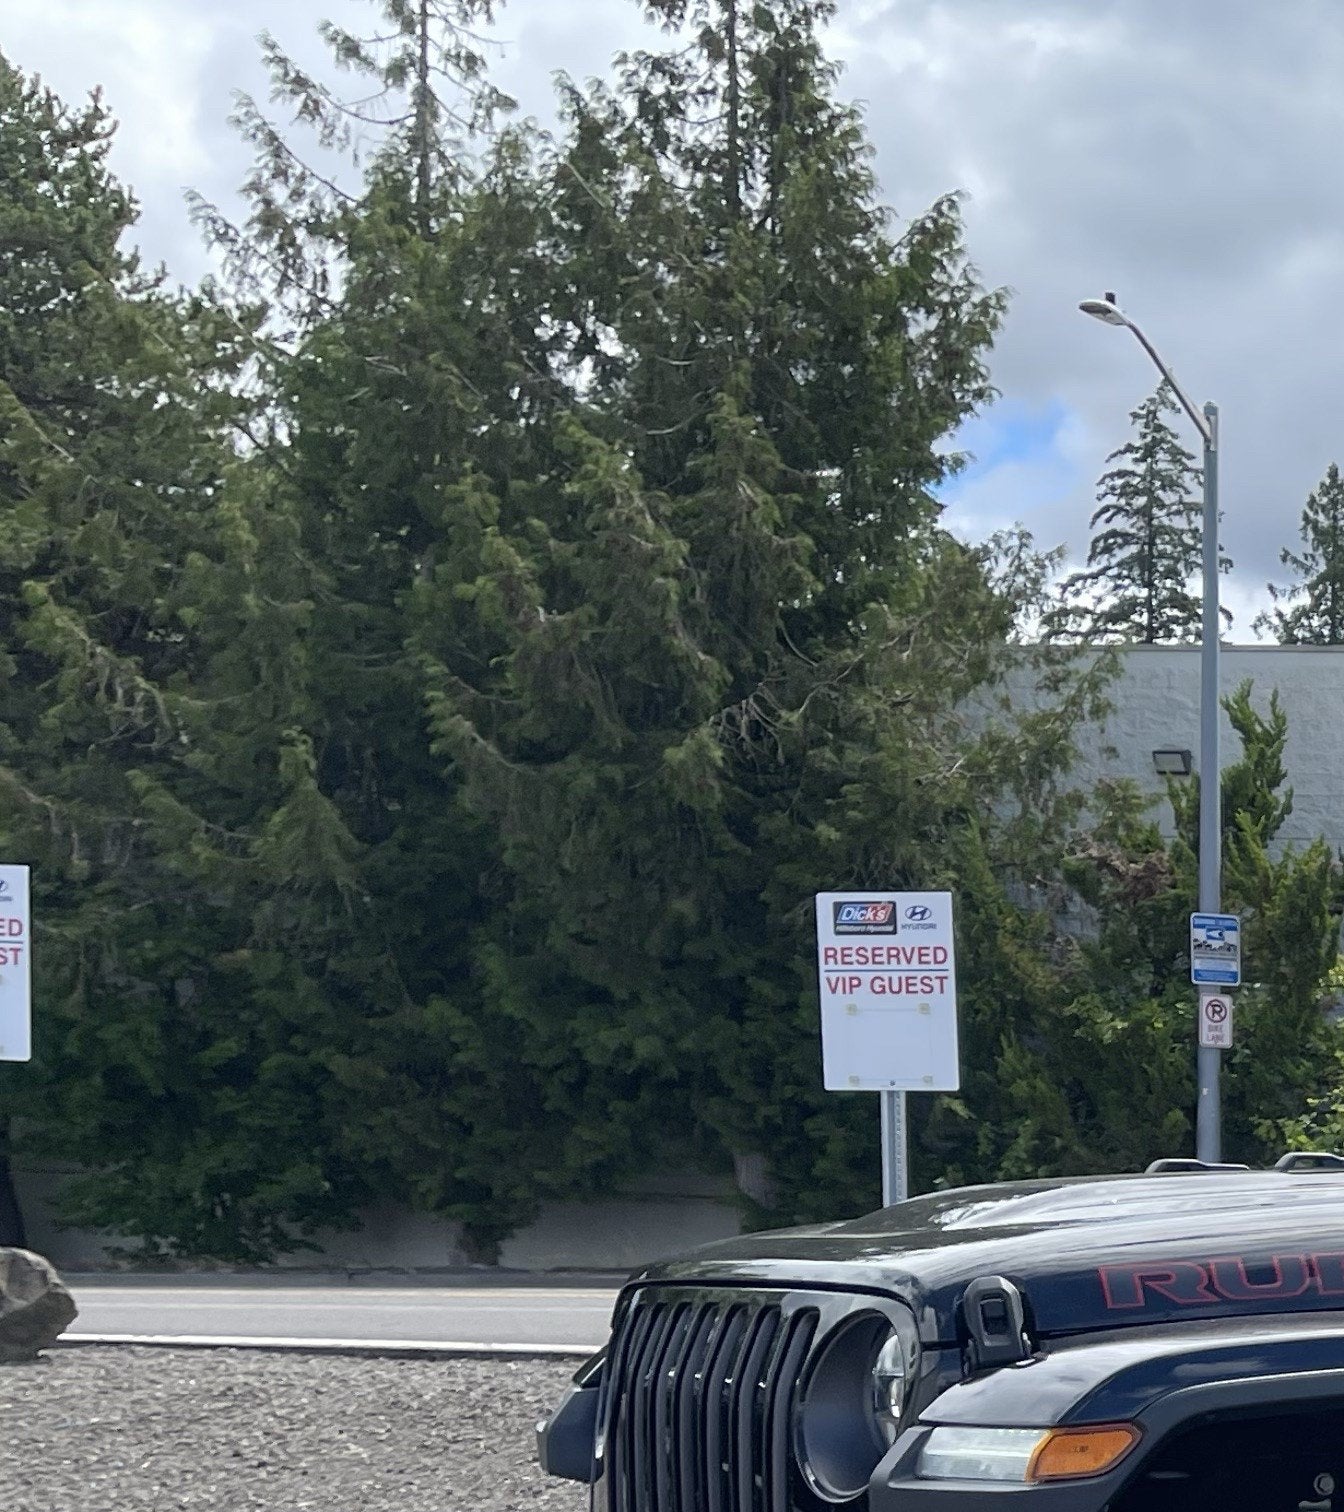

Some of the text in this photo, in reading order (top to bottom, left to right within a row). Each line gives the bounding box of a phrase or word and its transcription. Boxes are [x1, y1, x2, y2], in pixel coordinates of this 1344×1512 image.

[824, 946, 948, 966] RESERVED
[826, 976, 949, 995] VIP GUEST
